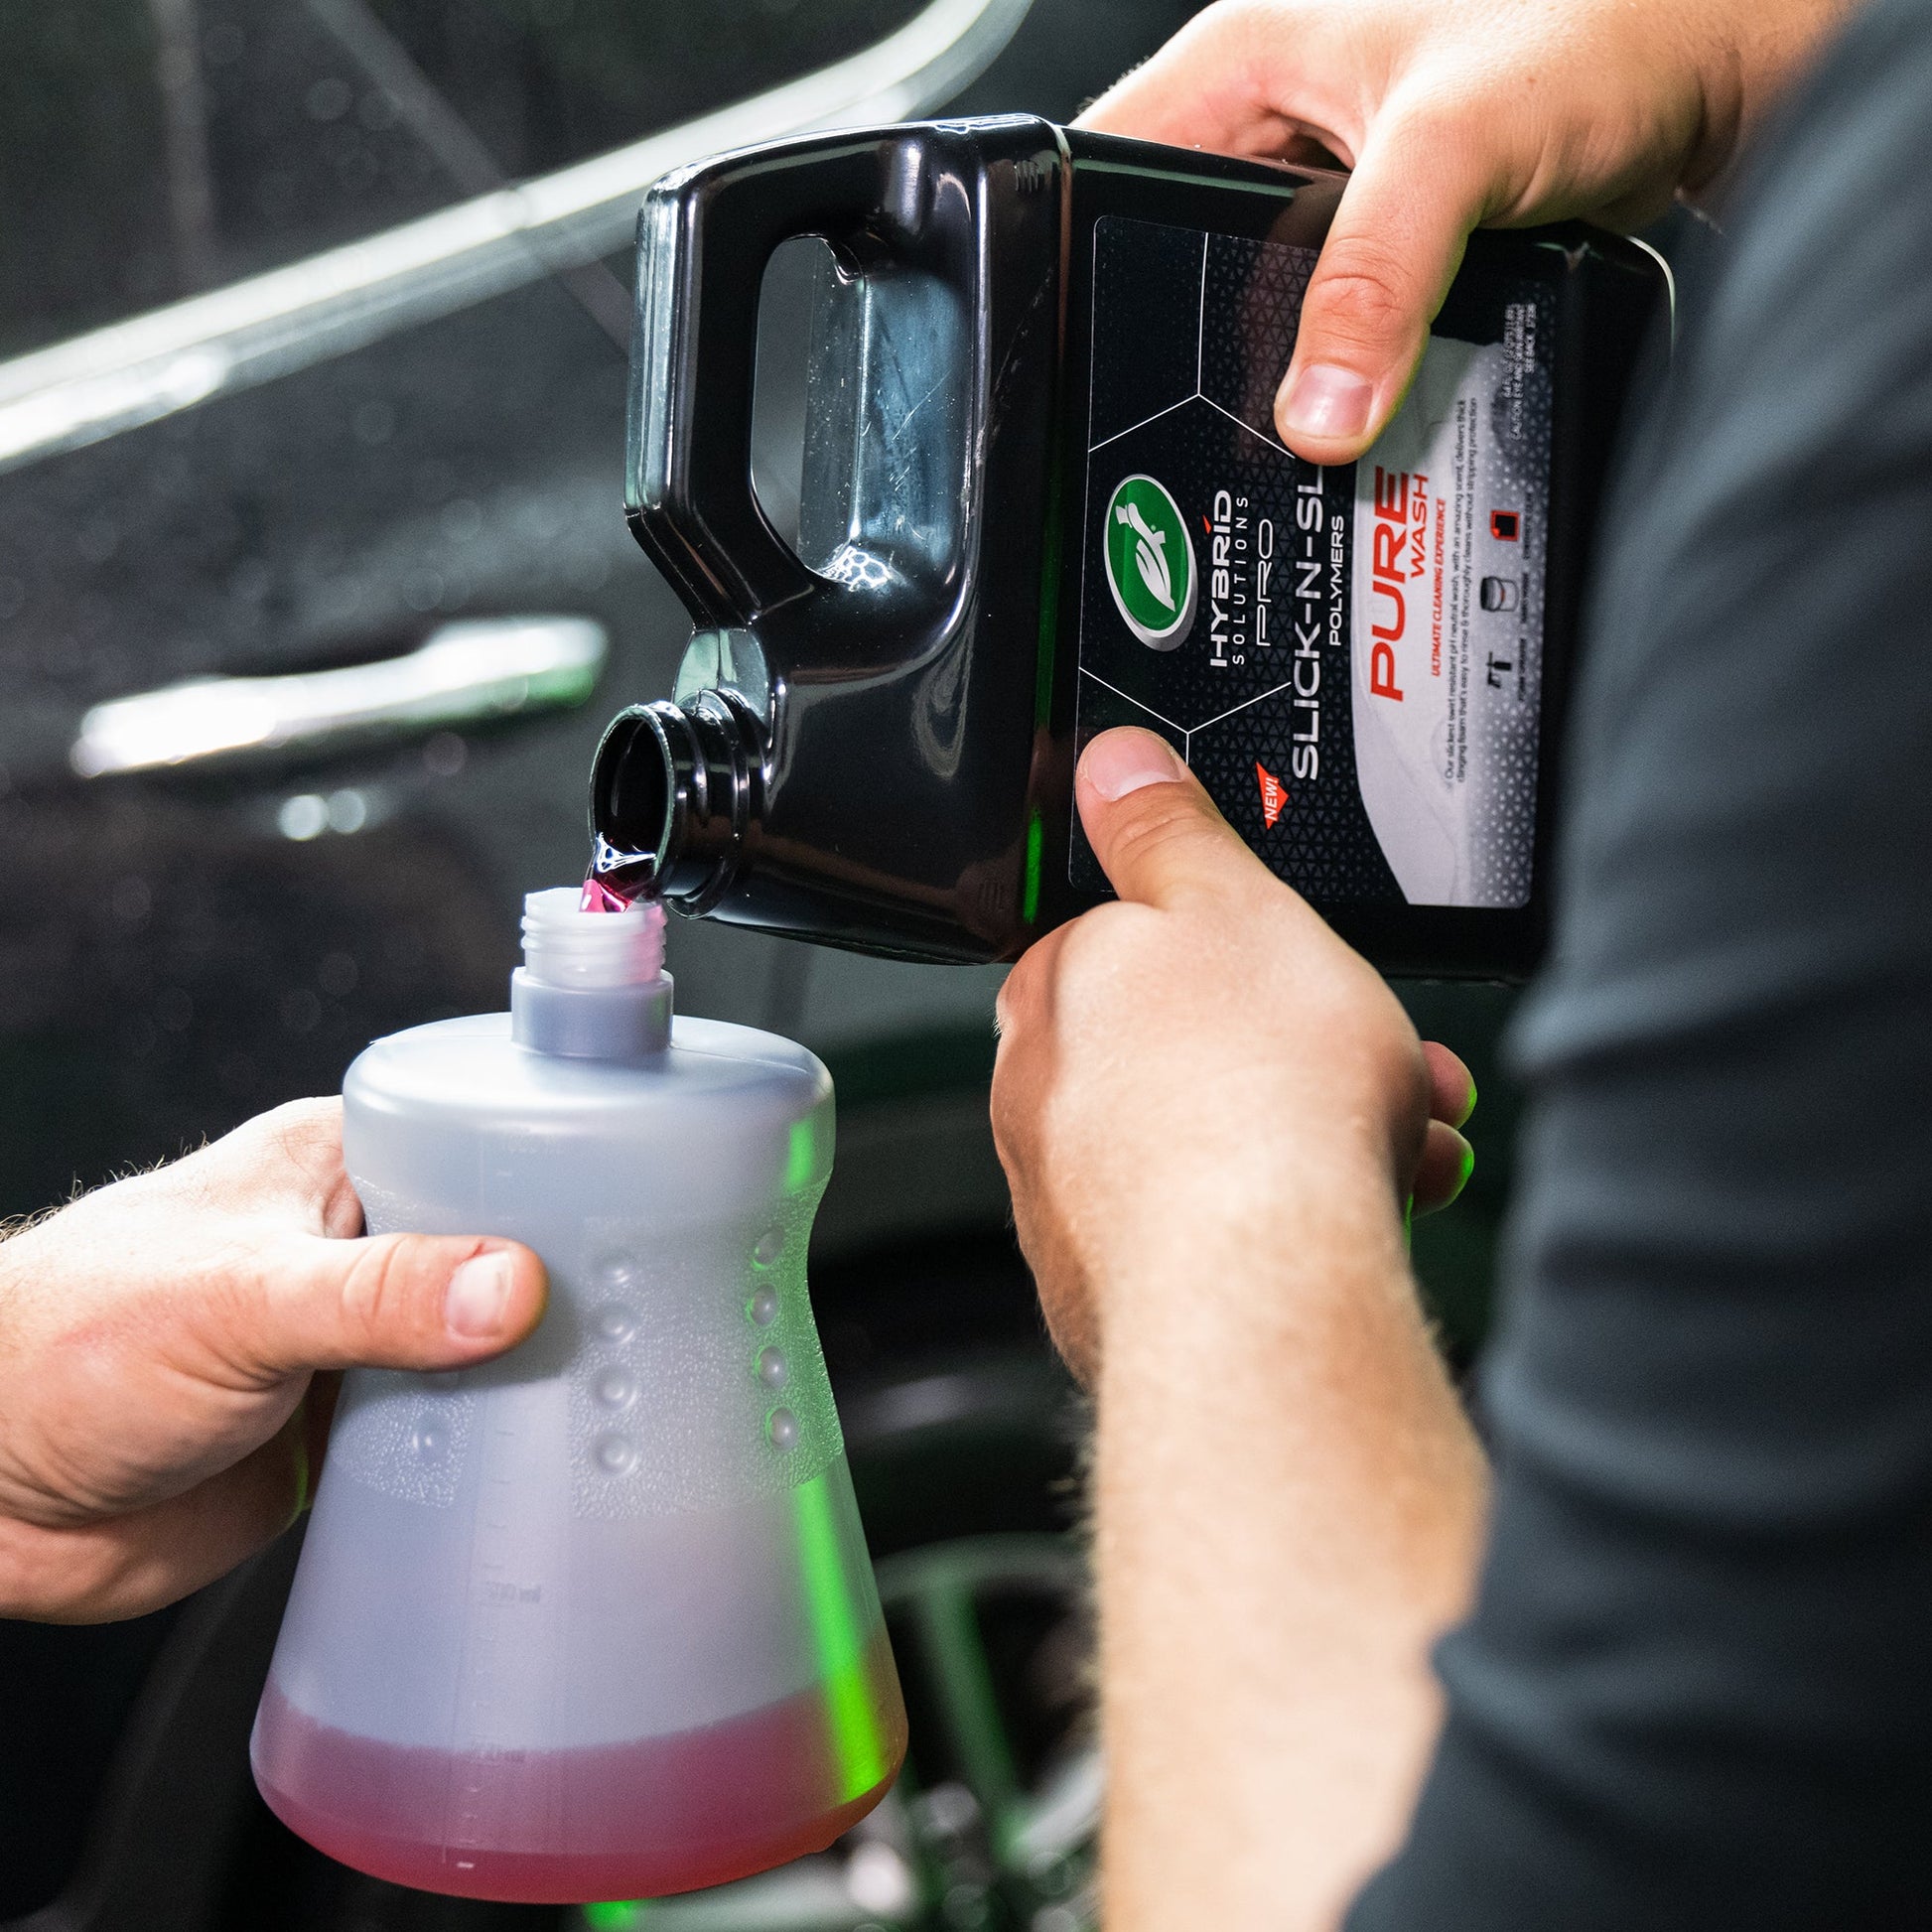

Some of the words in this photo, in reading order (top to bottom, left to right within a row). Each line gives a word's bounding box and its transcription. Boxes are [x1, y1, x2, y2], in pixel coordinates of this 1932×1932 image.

[1454, 424, 1465, 463] delivers
[1410, 474, 1430, 579] WASH
[1434, 497, 1447, 566] EXPERIENCE
[1453, 493, 1464, 534] amazing
[1465, 492, 1474, 531] without
[1451, 551, 1460, 573] with
[1453, 536, 1460, 549] an
[1463, 532, 1472, 564] cleans
[1232, 496, 1249, 665] SOLUTIONS
[1256, 518, 1274, 647] PRO
[1328, 515, 1344, 647] POLYMERS
[1369, 465, 1410, 703] PURE
[1433, 567, 1445, 622] CLEANING
[1461, 565, 1472, 618] thoroughly
[1292, 464, 1323, 781] SLICK-N-SL
[1460, 628, 1469, 652] rinse
[1431, 623, 1442, 678] ULTIMATE
[1449, 655, 1457, 697] resistant
[1460, 666, 1470, 690] easy
[1445, 759, 1454, 779] Our
[1264, 776, 1279, 822] NEW!
